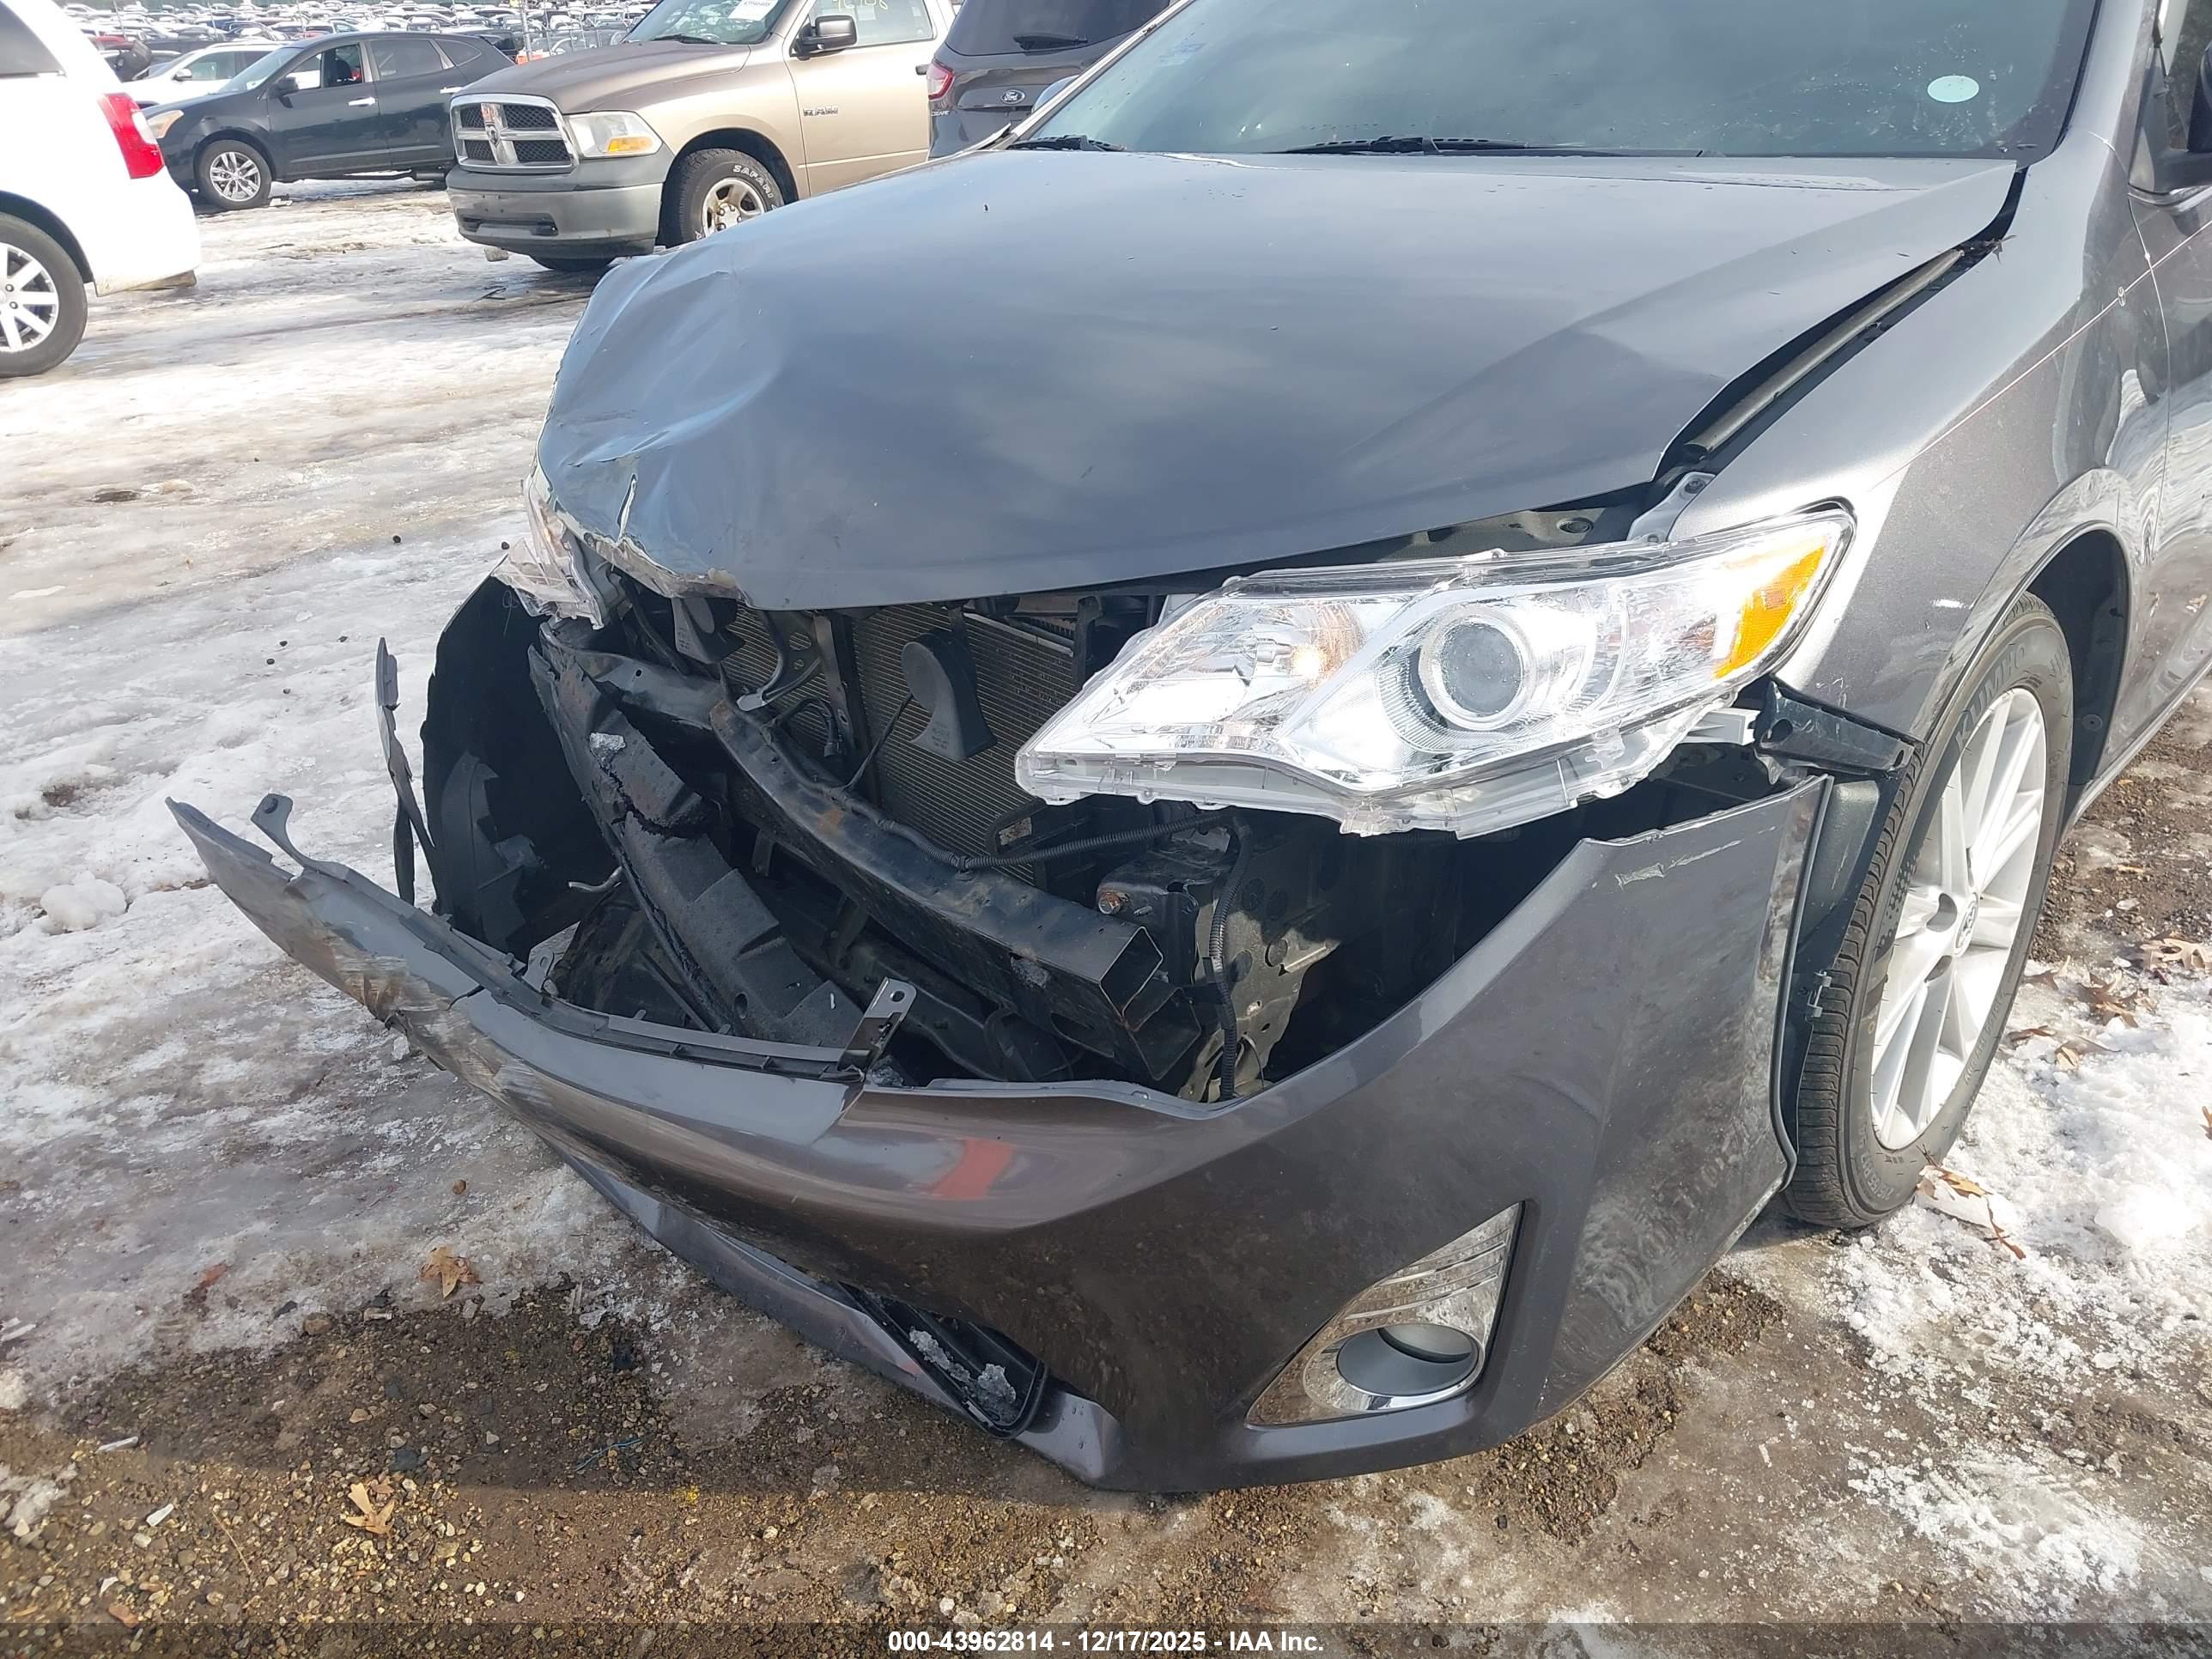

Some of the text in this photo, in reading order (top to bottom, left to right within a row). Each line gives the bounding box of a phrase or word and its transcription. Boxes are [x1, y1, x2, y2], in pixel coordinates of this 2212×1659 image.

[803, 106, 838, 117] RAM
[732, 165, 774, 198] SAFARI
[1955, 647, 2026, 752] KUMHO
